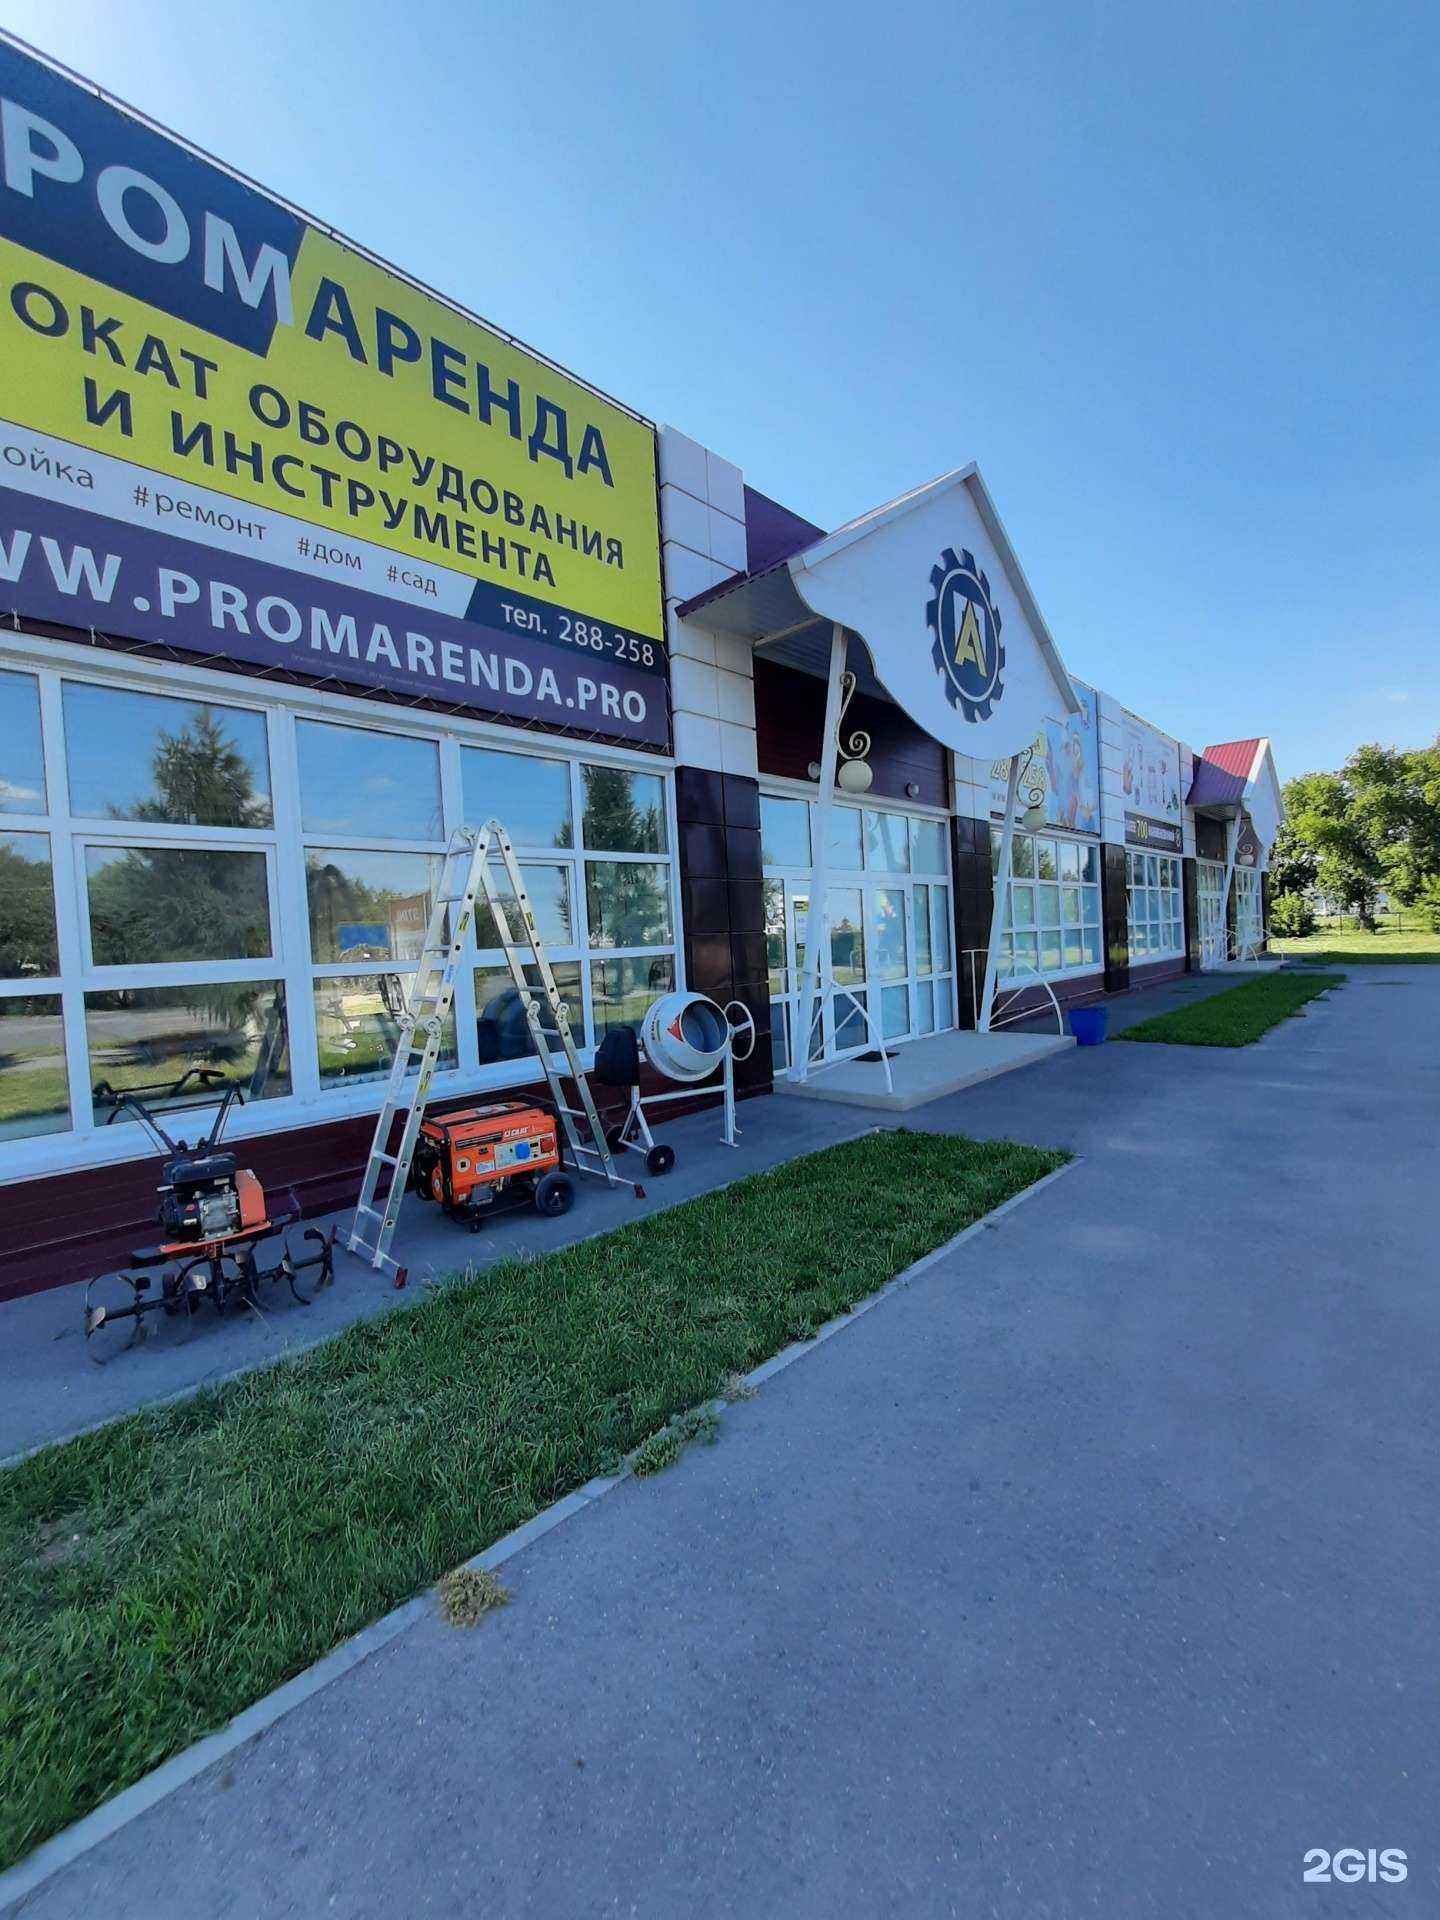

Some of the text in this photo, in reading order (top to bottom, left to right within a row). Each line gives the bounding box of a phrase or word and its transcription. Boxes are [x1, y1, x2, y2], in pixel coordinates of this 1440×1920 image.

[10, 281, 625, 570] ОКАТ ОБОРУДОВАНИЯ
[83, 376, 556, 588] И ИНСТРУМЕНТА
[3, 445, 438, 597] ойка #ремонт #дом #сад
[501, 601, 655, 667] тел. 288-258
